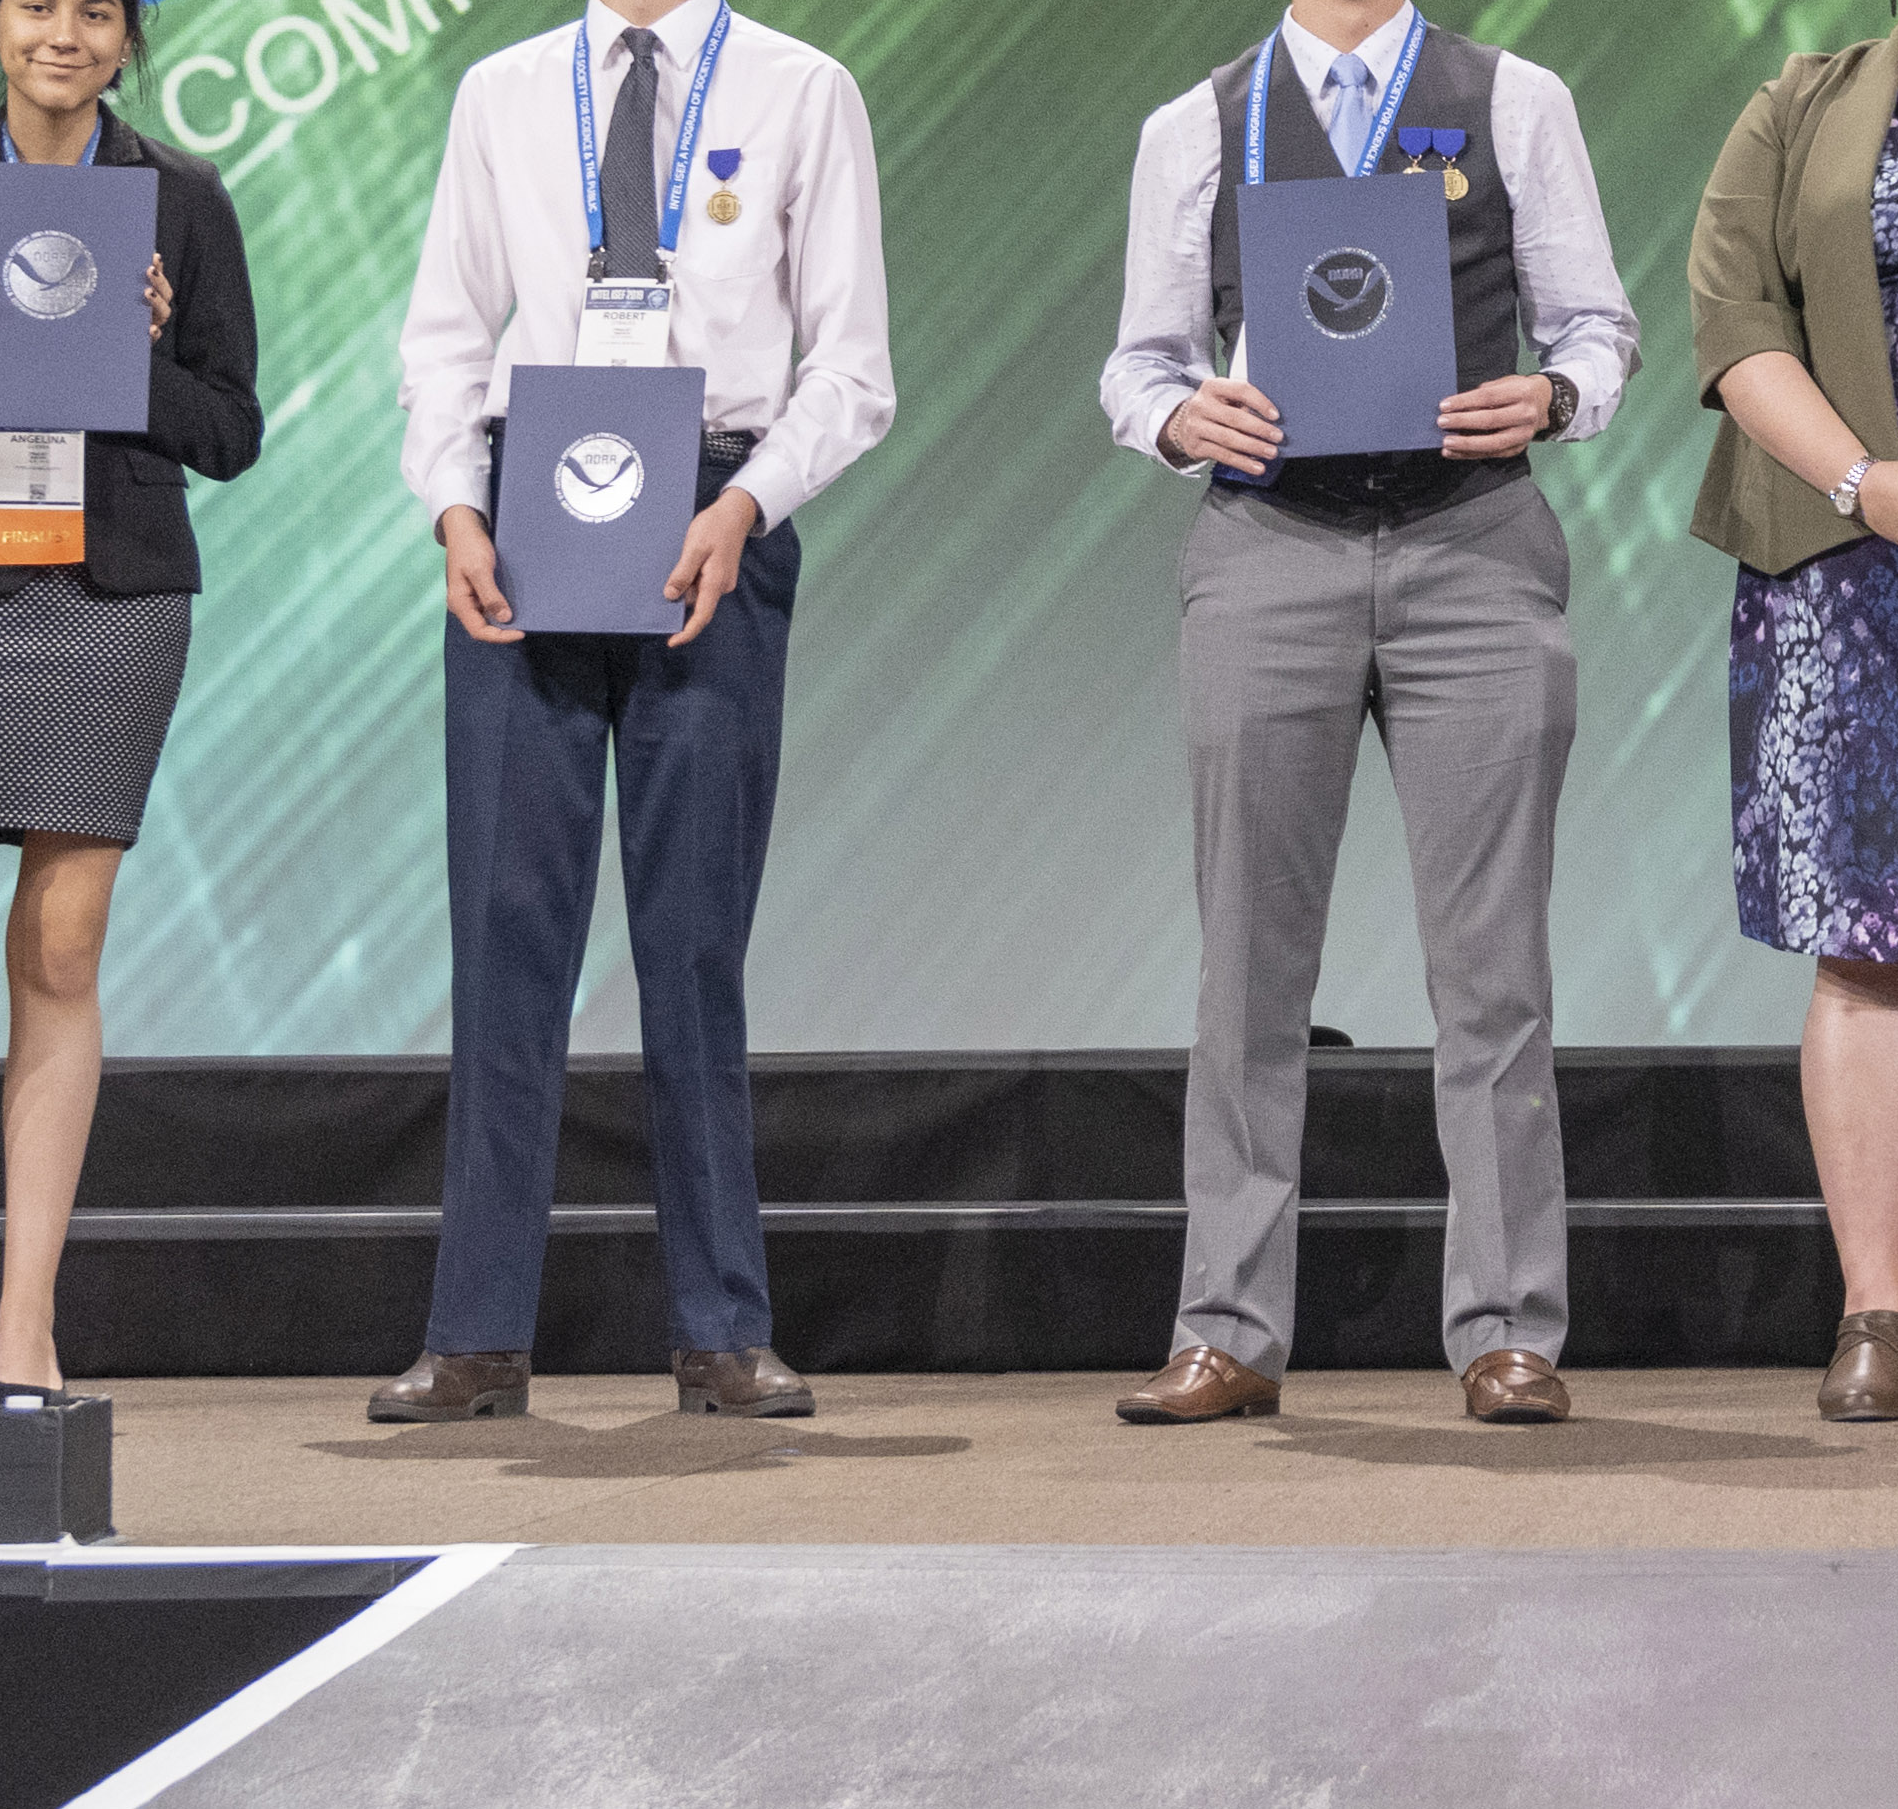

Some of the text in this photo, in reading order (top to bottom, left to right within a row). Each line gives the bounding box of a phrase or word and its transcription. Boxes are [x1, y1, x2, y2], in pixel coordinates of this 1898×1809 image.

[707, 37, 720, 56] FOR
[694, 55, 713, 91] SOCIETY
[1401, 59, 1413, 73] OF
[576, 58, 590, 96] SOCIETY
[690, 90, 702, 106] OF
[1387, 71, 1408, 108] SOCIETY
[579, 96, 591, 115] FOR
[1249, 103, 1262, 147] PROGRAM
[1380, 107, 1394, 126] FOR
[680, 105, 699, 151] PROGRAM
[1366, 124, 1388, 162] SCIENCE
[585, 160, 596, 180] THE
[668, 183, 683, 210] INTEL
[603, 311, 646, 321] ROBERT
[10, 434, 68, 444] ANGELINA
